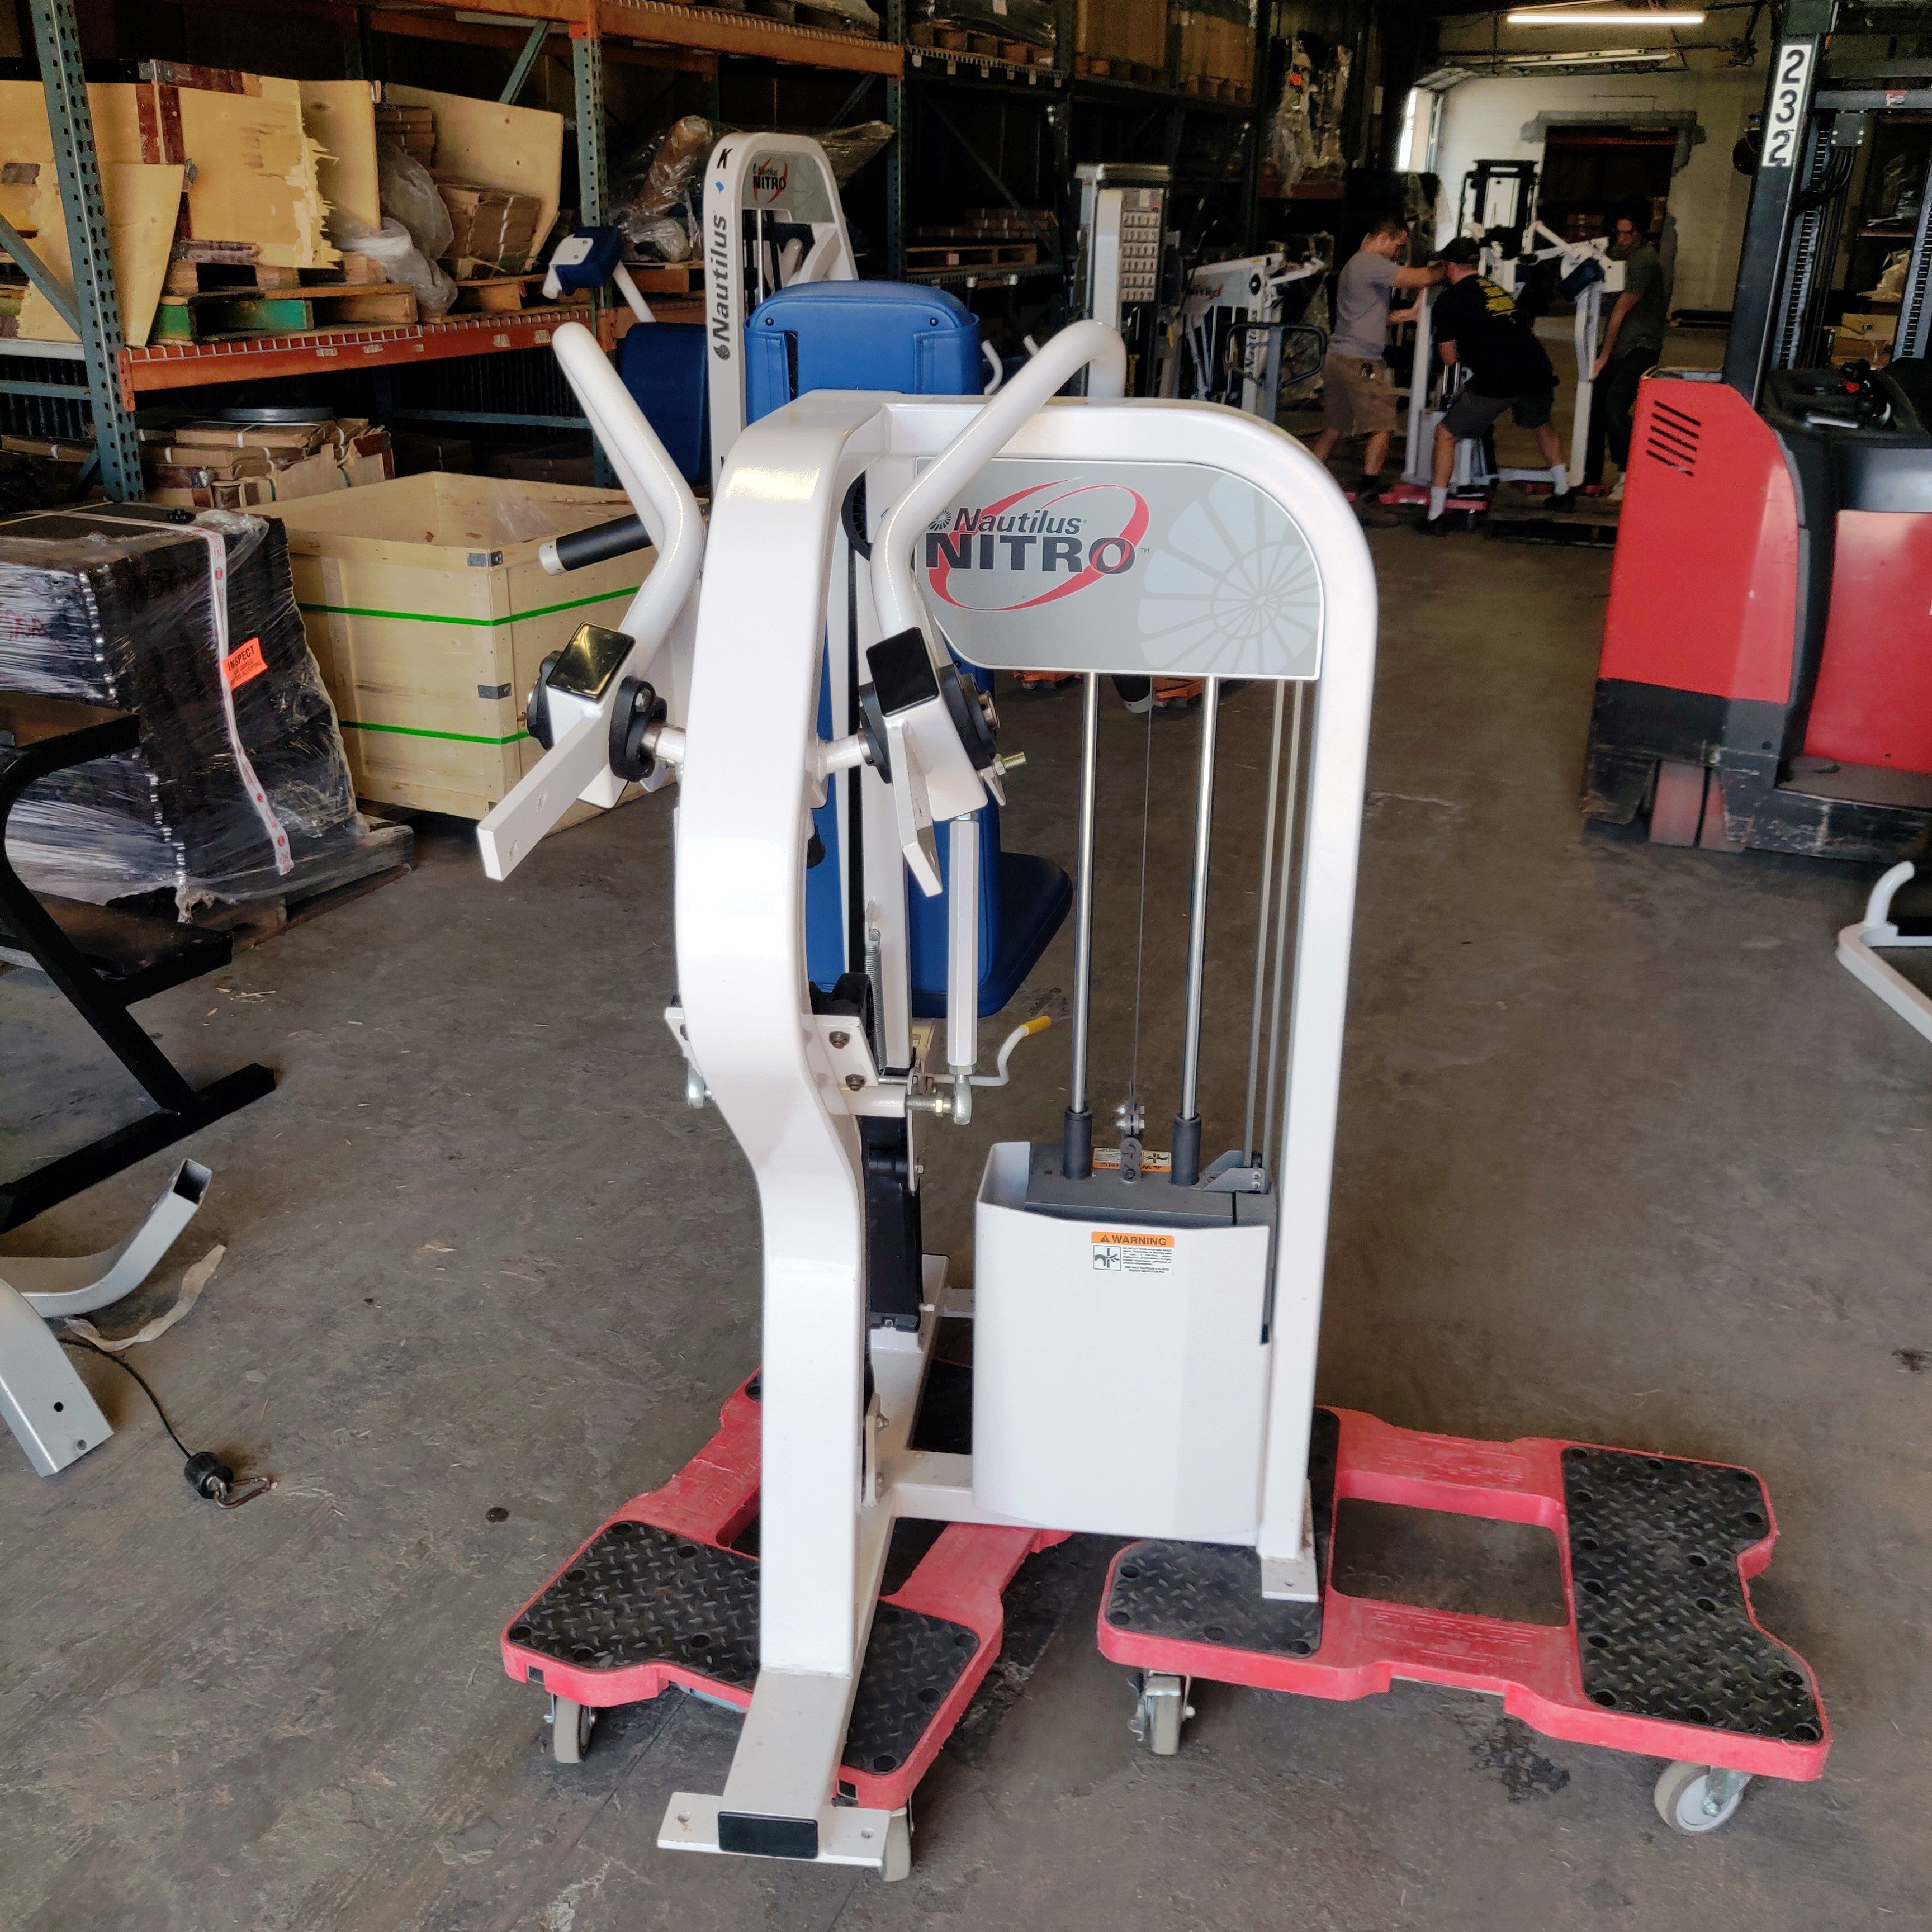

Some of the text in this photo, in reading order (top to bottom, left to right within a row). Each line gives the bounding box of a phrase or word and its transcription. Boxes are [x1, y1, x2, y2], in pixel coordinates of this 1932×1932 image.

[753, 175, 787, 190] NITRO
[710, 216, 730, 343] Nautilus
[954, 508, 1082, 534] Nautilus
[926, 532, 1135, 574] NITRO
[228, 645, 255, 671] INSPECT
[1112, 1235, 1167, 1246] WARNING
